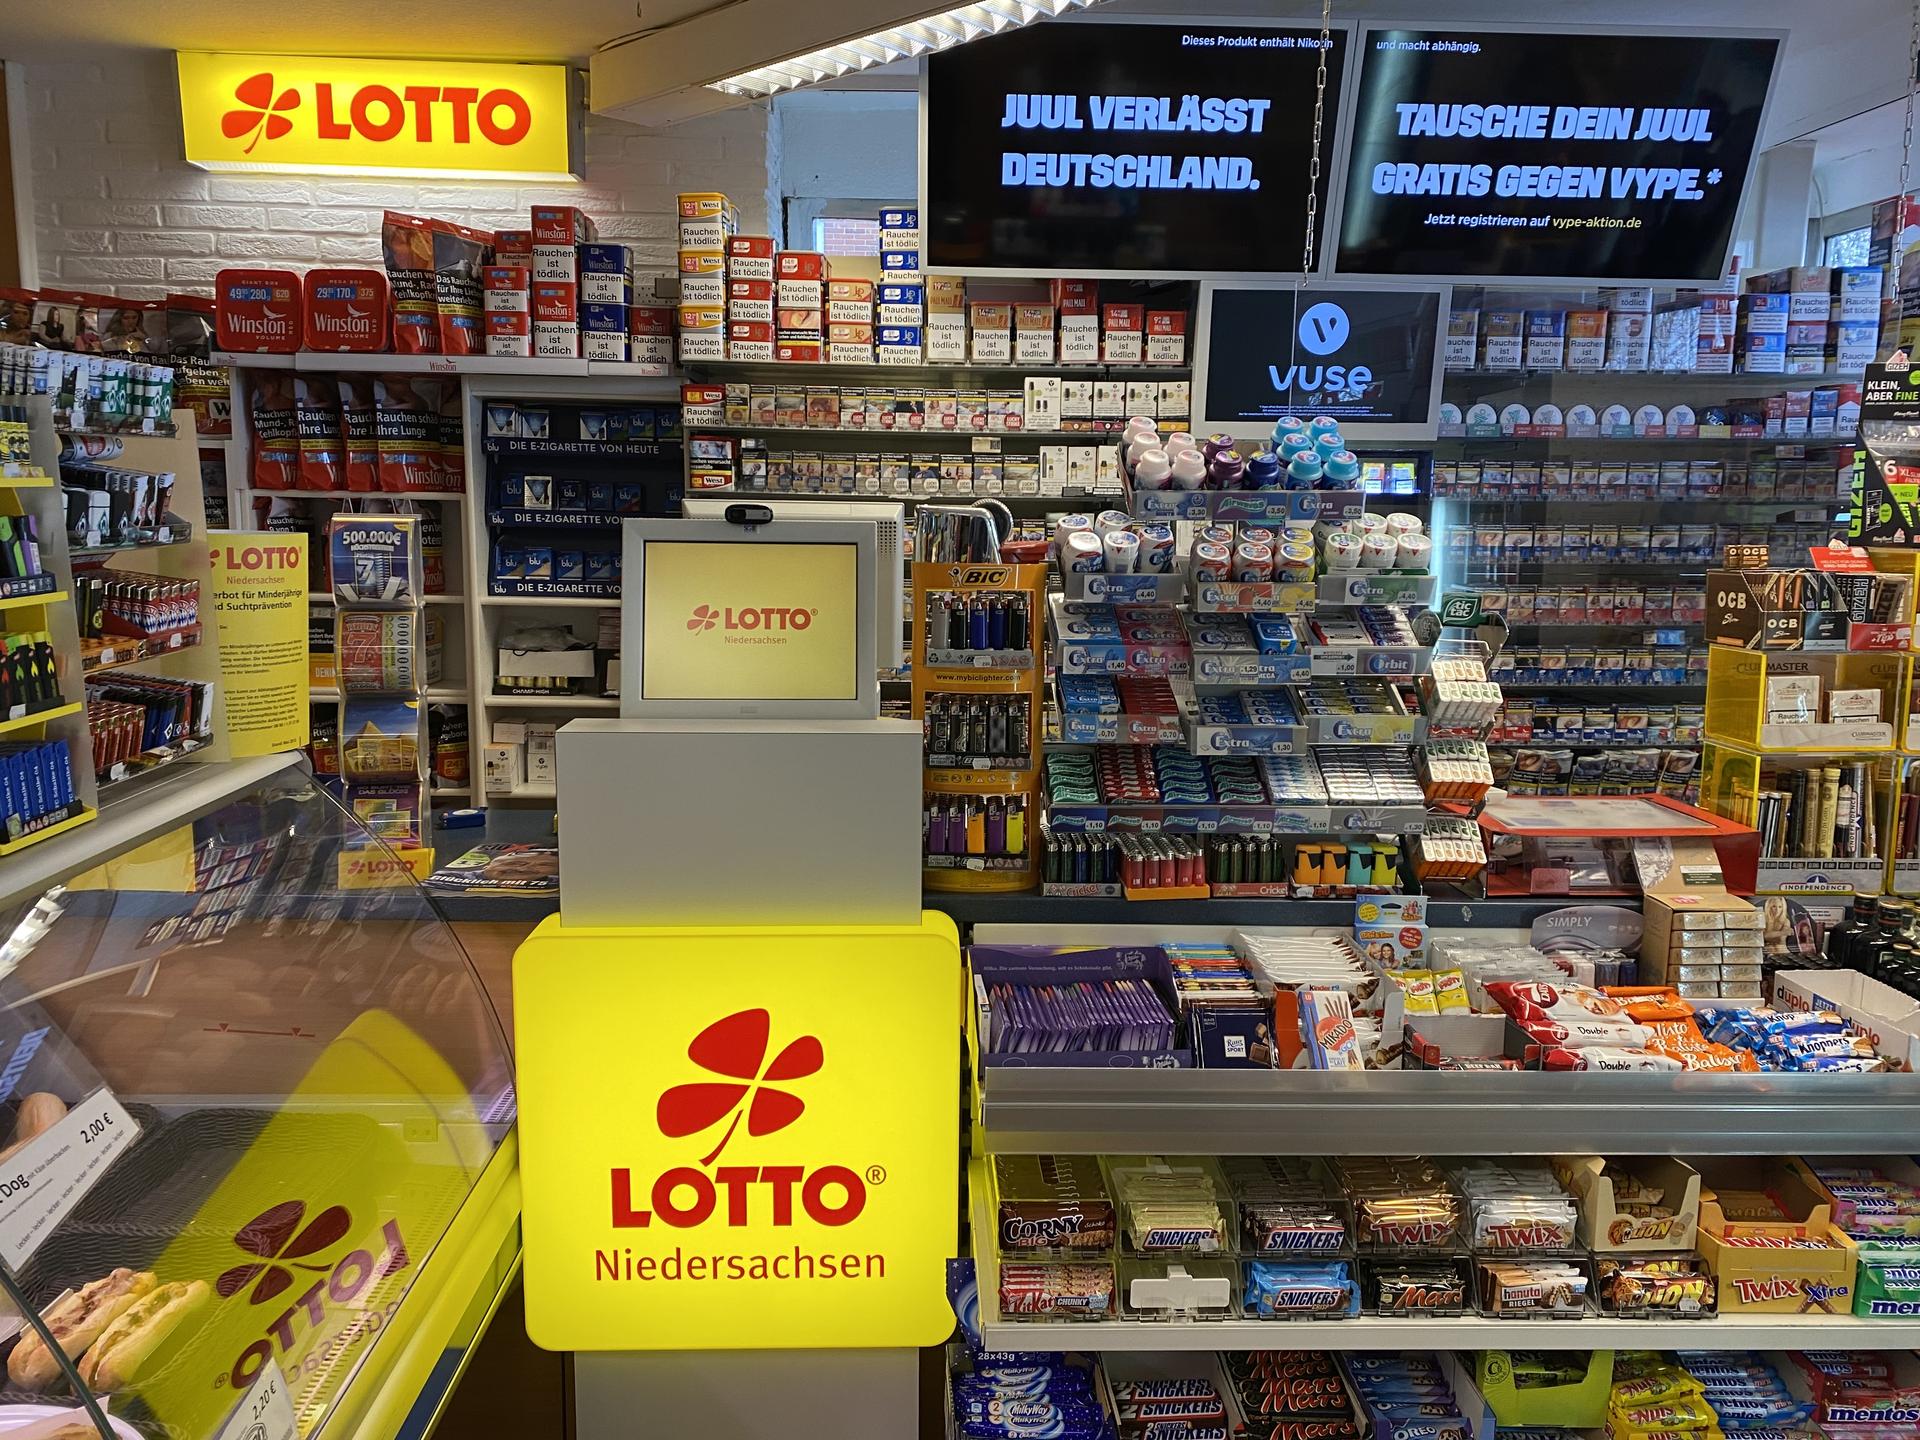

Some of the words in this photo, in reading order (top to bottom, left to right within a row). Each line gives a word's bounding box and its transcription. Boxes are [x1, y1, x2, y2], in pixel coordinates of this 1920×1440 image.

[1182, 35, 1215, 46] Dieses
[1217, 36, 1257, 47] Produkt
[1259, 37, 1295, 47] enthält
[1376, 40, 1396, 50] und
[1398, 41, 1430, 50] macht
[1432, 41, 1481, 53] abhängig.
[315, 83, 531, 146] LOTTO
[1001, 94, 1083, 129] JUUL
[1089, 95, 1270, 133] VERLÄSST
[1395, 103, 1550, 138] TAUSCHE
[1550, 106, 1635, 140] DEIN
[1635, 108, 1712, 142] JUUL
[1001, 152, 1260, 191] DEUTSCHLAND.
[1372, 162, 1494, 197] GRATIS
[1495, 164, 1601, 198] GEGEN
[1424, 213, 1455, 225] Jetzt
[1458, 214, 1527, 227] registrieren
[1530, 215, 1550, 227] auf
[1552, 216, 1642, 229] vype-aktion.de
[536, 229, 565, 239] Winston
[683, 228, 719, 236] Rauchen
[682, 237, 692, 245] ist
[694, 237, 722, 245] tödlich
[884, 240, 894, 248] ist
[532, 249, 574, 258] Rauchen
[547, 259, 559, 268] ist
[436, 274, 450, 283] Das
[536, 269, 570, 279] tödlich
[437, 285, 449, 294] für
[450, 285, 463, 294] Ihre
[537, 305, 567, 316] Winston
[884, 305, 920, 314] Rauchen
[227, 312, 286, 334] Winston
[314, 312, 369, 333] Winston
[882, 315, 892, 323] ist
[894, 315, 922, 323] tödlich
[1062, 325, 1098, 333] Rauchen
[1074, 333, 1085, 342] ist
[1107, 333, 1141, 342] Rauchen
[1529, 339, 1562, 348] Rauchen
[1065, 343, 1094, 351] tödlich
[1540, 348, 1550, 356] ist
[170, 354, 187, 364] Das
[1109, 350, 1137, 359] tödlich
[1531, 356, 1558, 364] tödlich
[1268, 363, 1373, 392] vuse
[1867, 380, 1901, 391] KLEIN,
[704, 391, 721, 399] West
[1866, 391, 1893, 401] ABER
[1894, 391, 1918, 400] FINE
[299, 424, 321, 434] Ihre
[377, 426, 399, 436] Ihre
[401, 427, 426, 438] Lunge
[510, 441, 527, 450] DIE
[530, 442, 596, 453] E-ZIGARETTE
[600, 444, 625, 453] VON
[626, 444, 660, 454] HEUTE
[1848, 450, 1867, 538] GIZEH
[1301, 495, 1333, 511] Extra
[515, 513, 532, 523] DIE
[535, 514, 601, 524] E-ZIGARETTE
[343, 530, 401, 545] 500.000€
[1743, 547, 1767, 555] OCB
[226, 546, 299, 570] LOTTO
[226, 576, 285, 585] Niedersachsen
[1091, 580, 1123, 593] Extra
[517, 583, 534, 592] DIE
[537, 583, 603, 593] E-ZIGARETTE
[213, 591, 239, 600] erbot
[242, 590, 256, 599] für
[258, 589, 302, 600] Minderjährige
[1717, 591, 1747, 610] OCB
[226, 601, 293, 612] Suchtprävention
[1455, 600, 1472, 611] tic
[1450, 608, 1470, 617] tac
[725, 607, 812, 631] LOTTO
[1767, 618, 1798, 628] OCB
[724, 635, 787, 645] Niedersachsen
[1214, 735, 1249, 749] Extra
[368, 860, 416, 874] LOTTO
[1066, 884, 1101, 897] Cricket
[1259, 885, 1288, 896] Cricket
[1546, 916, 1592, 928] SIMPLY
[1777, 985, 1810, 1013] duplo
[1319, 1019, 1353, 1050] MIKADO
[1577, 1026, 1608, 1037] Double
[1799, 1036, 1849, 1054] Knoppers
[1599, 1060, 1631, 1071] Double
[80, 1118, 105, 1144] 2,00
[104, 1112, 113, 1125] €
[0, 1174, 30, 1198] Dog
[611, 1165, 866, 1229] LOTTO
[1003, 1214, 1084, 1243] CORNY
[1018, 1236, 1048, 1247] BIG
[1149, 1229, 1211, 1246] SNICKERS
[1266, 1230, 1345, 1250] SNICKERS
[595, 1246, 885, 1281] Niedersachsen
[1277, 1290, 1341, 1307] SNICKERS
[1394, 1285, 1463, 1309] Mars
[1503, 1285, 1541, 1301] hanuta
[1807, 1284, 1848, 1302] Xtra
[1057, 1297, 1088, 1306] CHUNKY
[1508, 1298, 1536, 1308] RIEGEL
[978, 1352, 1015, 1362] 28x43g
[1261, 1376, 1341, 1395] Mars
[252, 1392, 270, 1421] 2,20
[1143, 1401, 1223, 1416] SNICKERS
[1828, 1407, 1920, 1422] mentos
[1393, 1426, 1436, 1440] OREO
